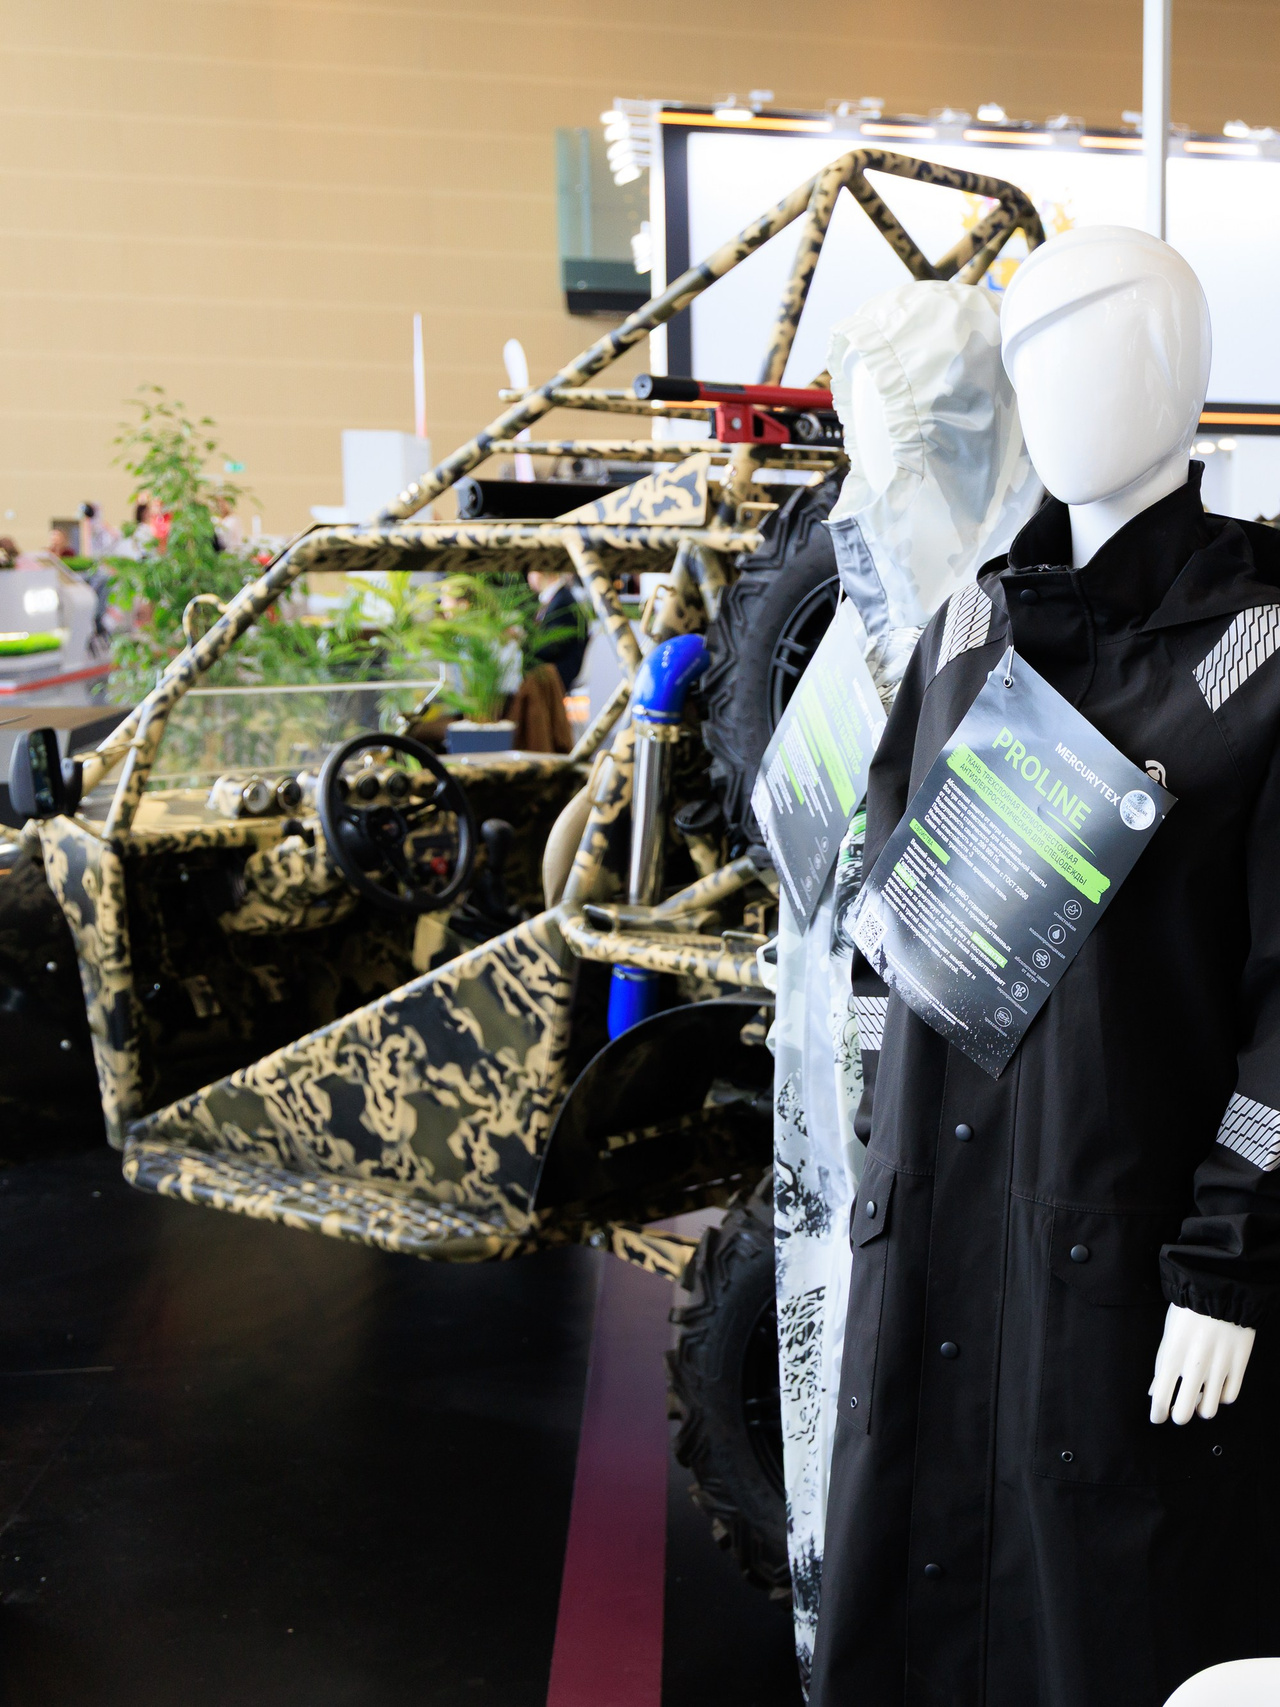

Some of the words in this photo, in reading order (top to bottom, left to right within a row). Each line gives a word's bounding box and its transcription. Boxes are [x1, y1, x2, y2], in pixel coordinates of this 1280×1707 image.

[990, 724, 1092, 831] PROLINE
[1054, 741, 1121, 806] MERCURYTEX
[913, 821, 934, 846] СВОЙСТВА
[959, 761, 1032, 836] АНТИЭЛЕКТРОСТАТИЧЕСКАЯ
[1030, 832, 1045, 849] ДЛЯ
[1042, 843, 1087, 886] СПЕЦОДЕЖДЫ
[964, 753, 983, 775] ТКАНЬ
[980, 770, 1021, 811] ТРЕХСЛОЙНАЯ
[1018, 806, 1079, 865] ТЕРМООГНЕСТОЙКАЯ
[983, 815, 990, 823] от
[948, 890, 956, 899] от
